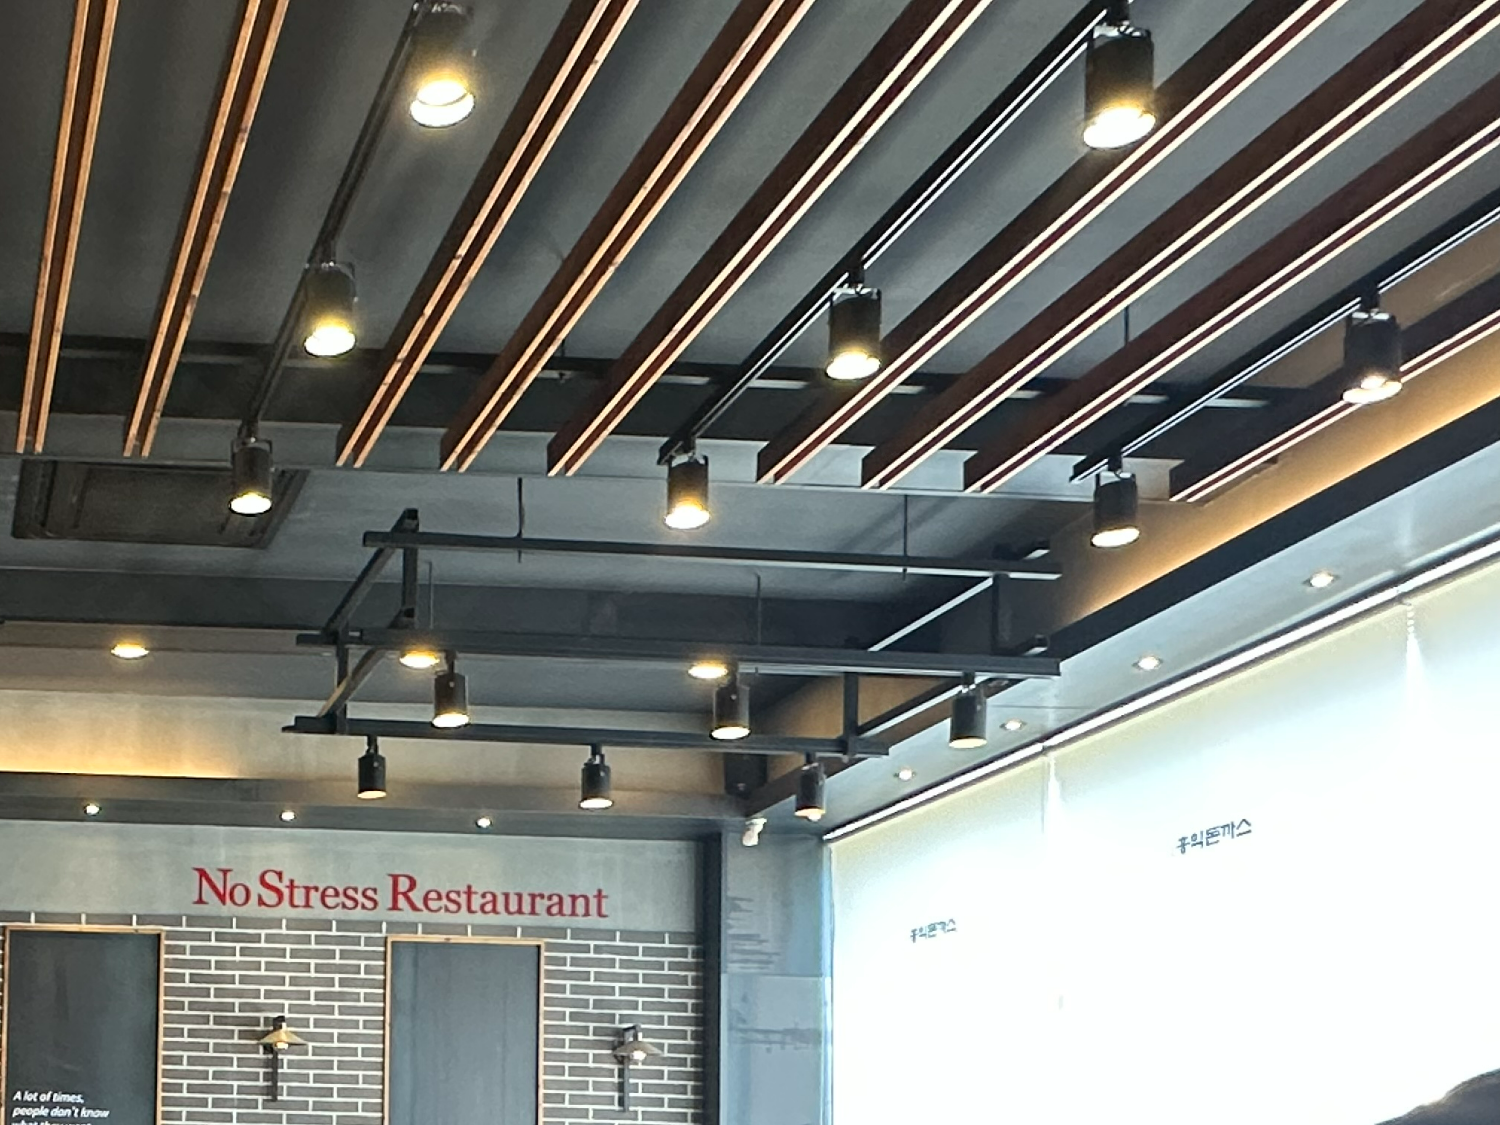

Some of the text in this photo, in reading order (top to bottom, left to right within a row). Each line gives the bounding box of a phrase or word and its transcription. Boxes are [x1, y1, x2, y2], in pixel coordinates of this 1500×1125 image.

[1177, 819, 1252, 854] 홍익돈까스
[192, 867, 609, 918] No Stress Restaurant
[13, 1091, 85, 1104] A lot of times,
[12, 1106, 110, 1118] people don't know
